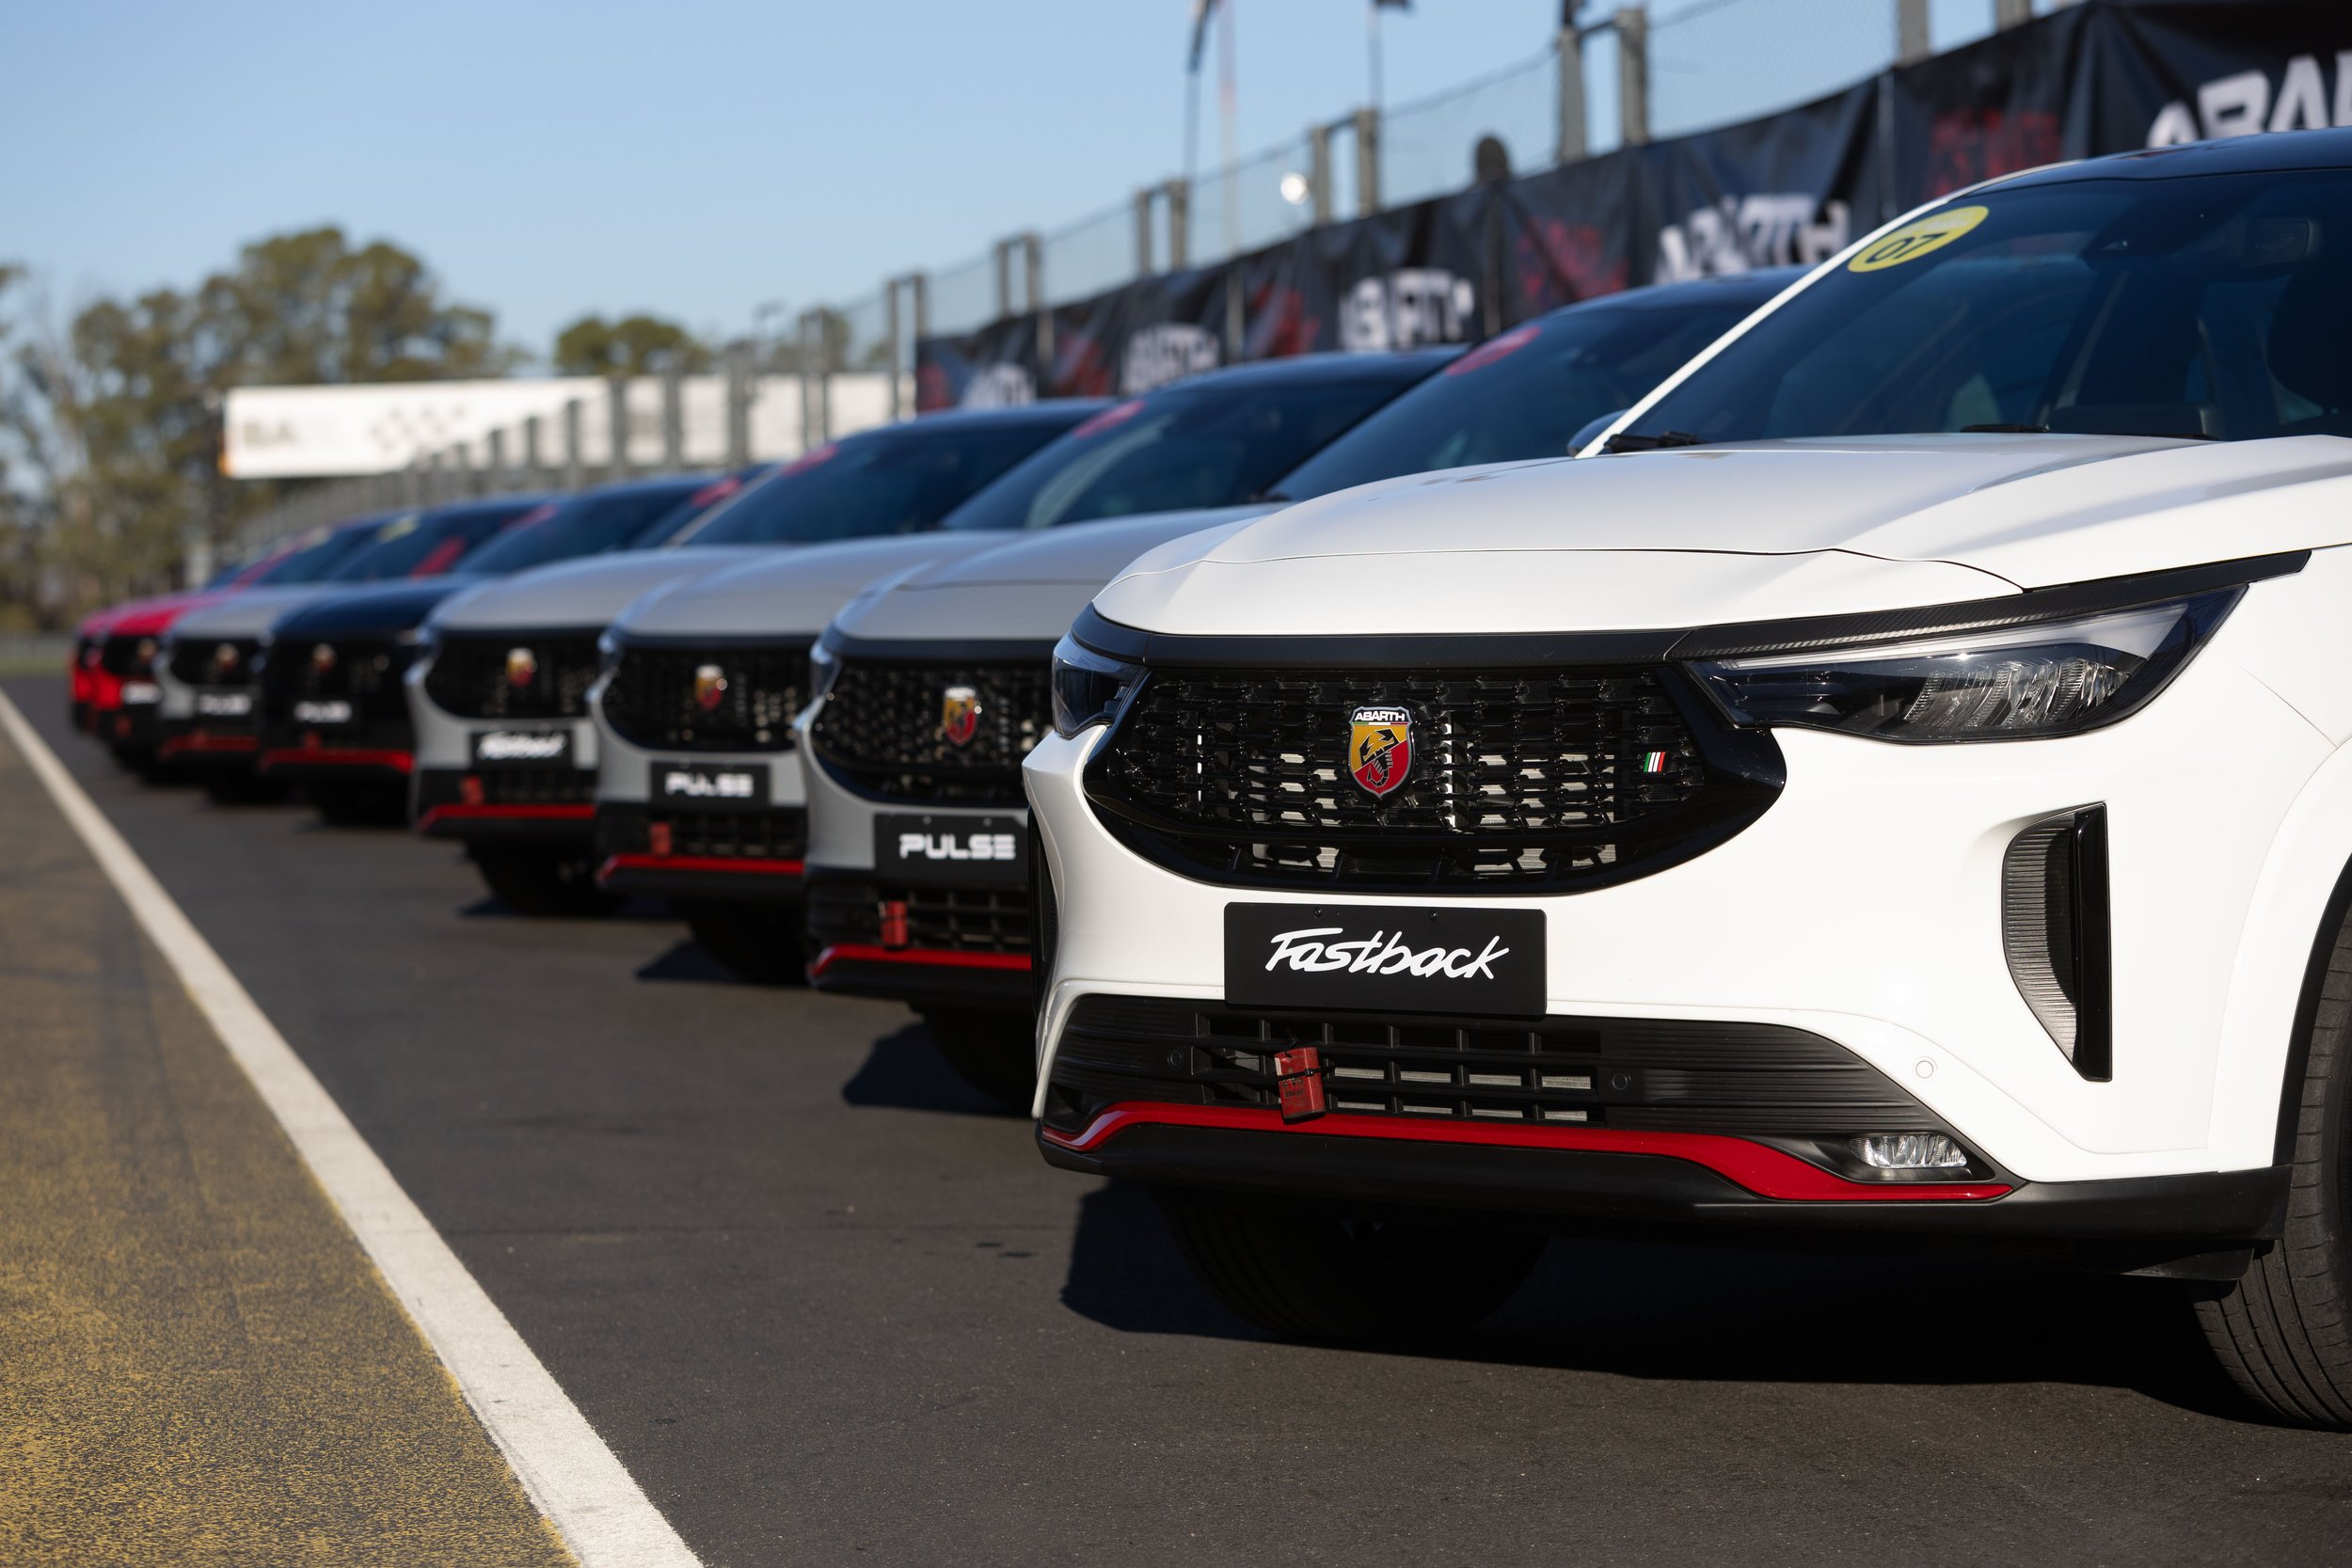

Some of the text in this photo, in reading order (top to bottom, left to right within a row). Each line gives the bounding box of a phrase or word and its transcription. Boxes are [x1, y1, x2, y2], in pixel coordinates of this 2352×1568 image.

[2144, 51, 2352, 150] ABA
[1865, 231, 1948, 264] 07
[1355, 710, 1406, 721] ABARTH
[899, 833, 1016, 861] PULSE
[1265, 927, 1510, 979] Fastback
